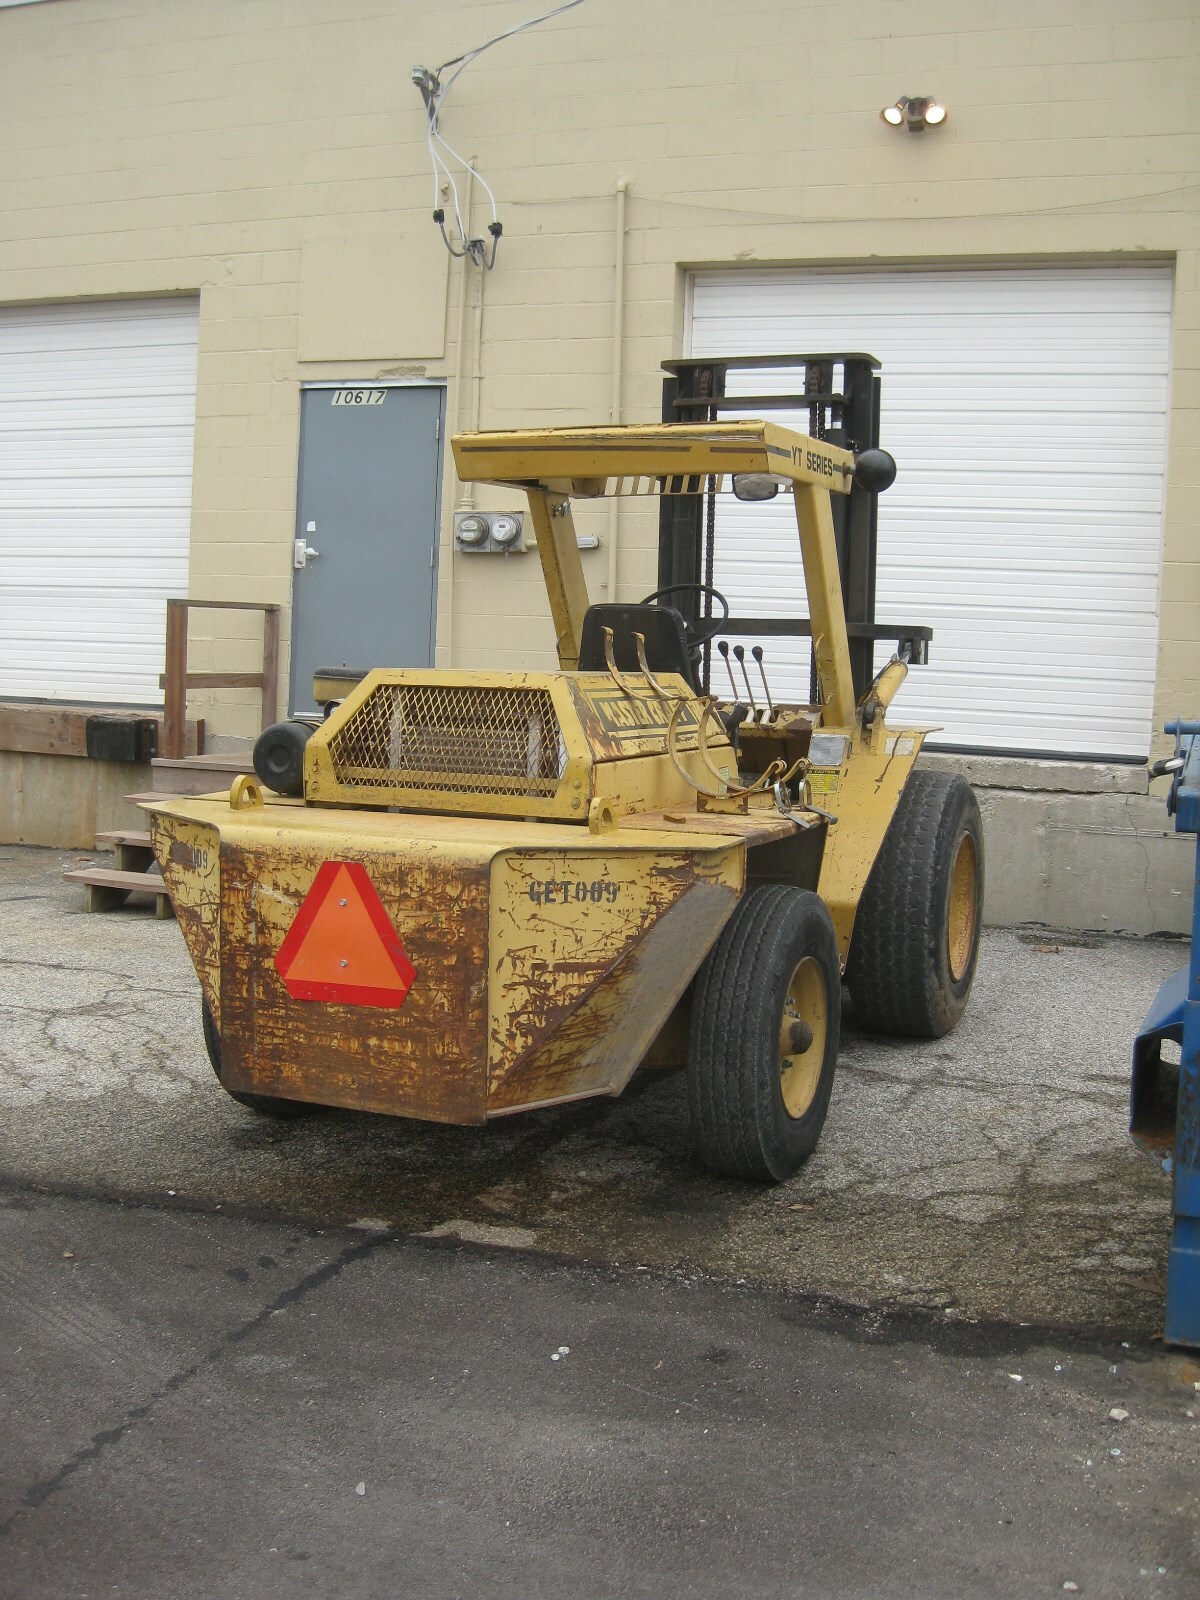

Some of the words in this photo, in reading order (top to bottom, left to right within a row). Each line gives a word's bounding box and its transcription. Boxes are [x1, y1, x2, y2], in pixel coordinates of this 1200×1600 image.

[335, 390, 386, 404] 10617
[791, 445, 803, 467] YT
[806, 450, 833, 477] SERIES
[529, 880, 618, 903] GET009
